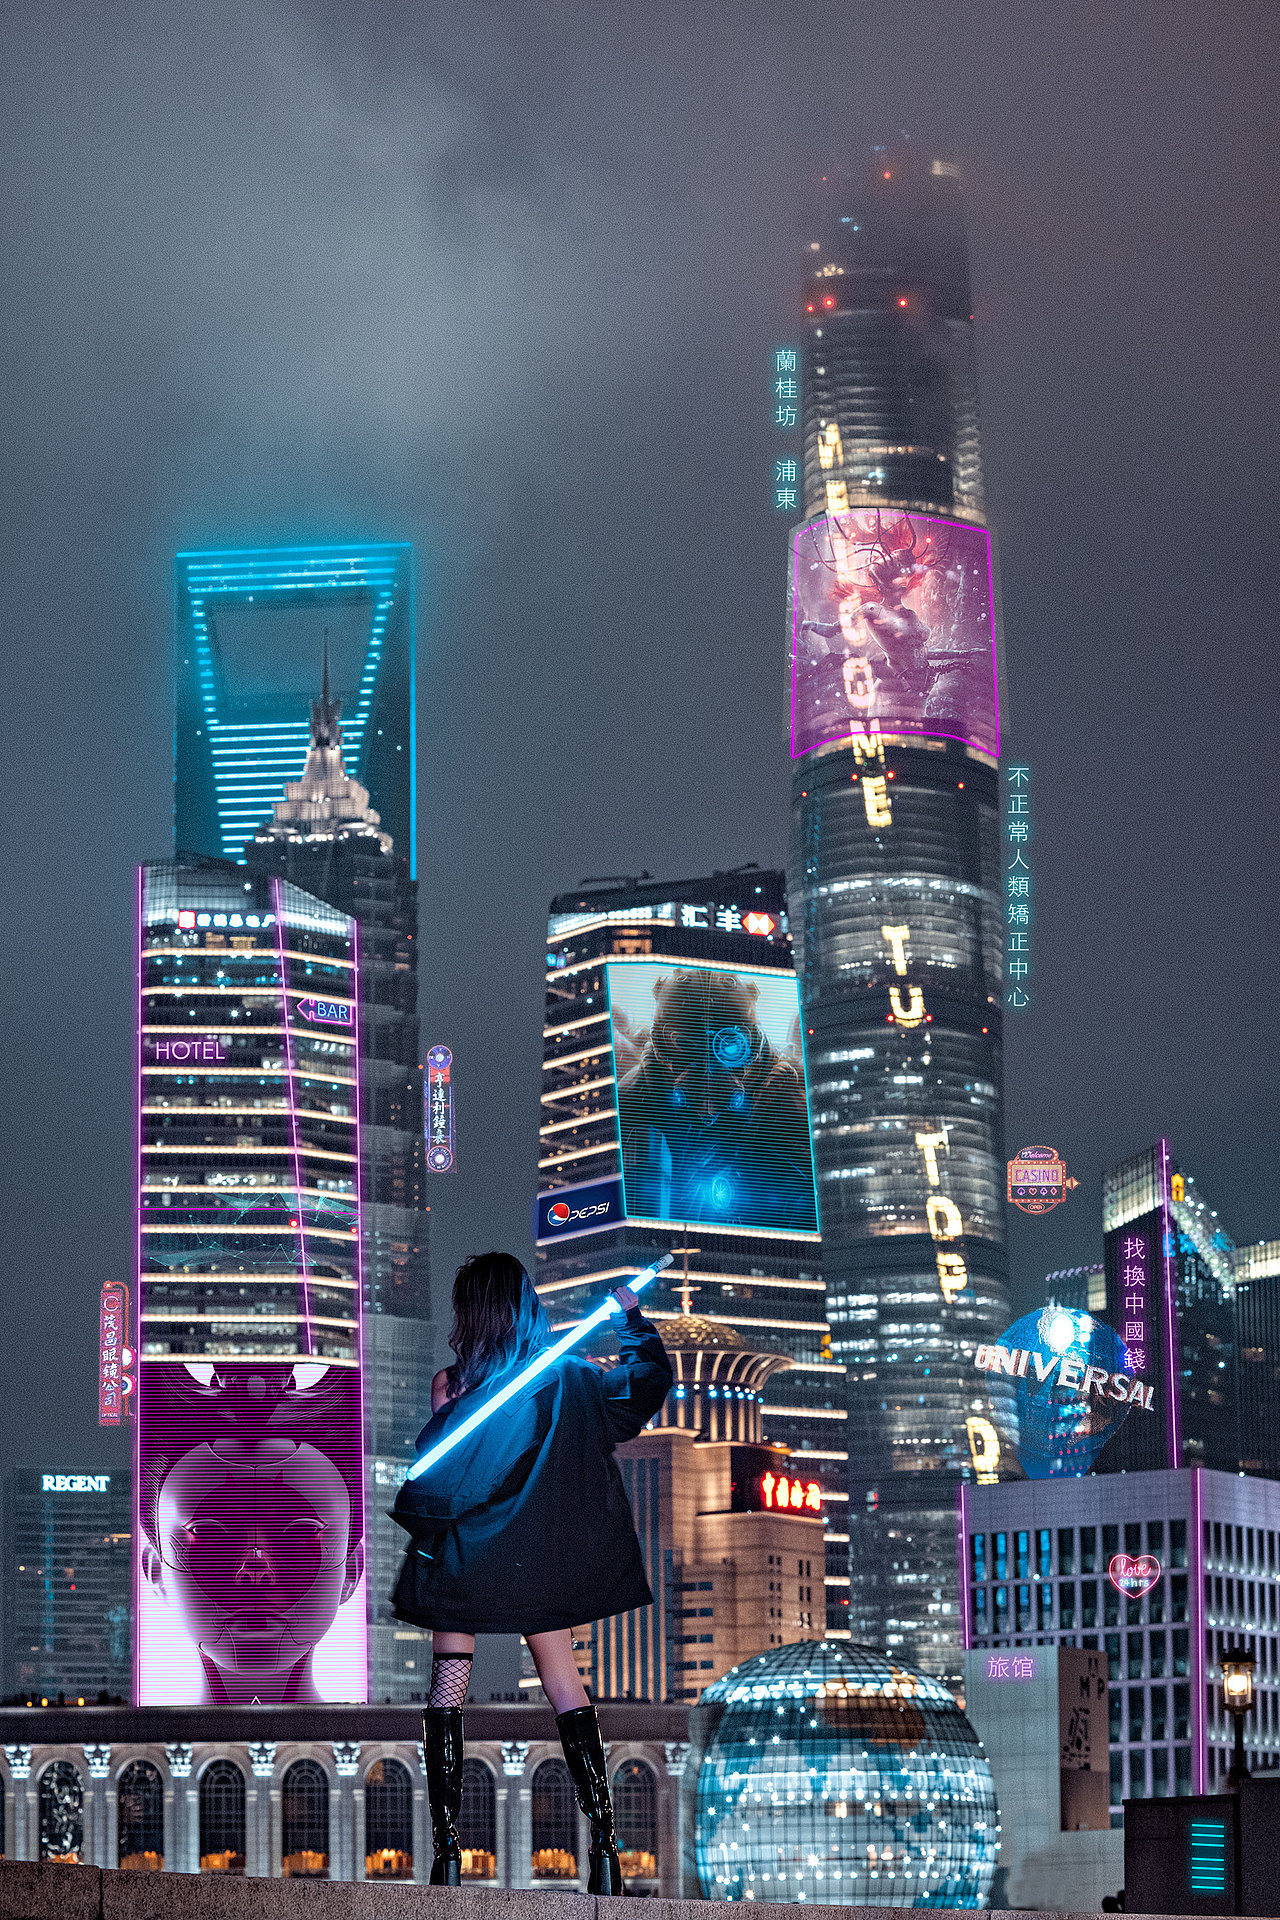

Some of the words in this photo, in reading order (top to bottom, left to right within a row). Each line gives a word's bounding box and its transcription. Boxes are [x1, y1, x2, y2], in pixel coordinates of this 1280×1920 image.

[775, 349, 798, 427] 蘭桂坊
[775, 459, 798, 510] 浦東
[1007, 767, 1030, 1007] 不正常人類矯正中心
[680, 903, 742, 932] 汇丰
[316, 1002, 348, 1020] BAR
[156, 1041, 226, 1060] HOTEL
[1015, 1169, 1059, 1183] CASINO
[568, 1201, 611, 1223] PEPSI
[1123, 1237, 1146, 1370] 找換中國錢
[974, 1344, 1155, 1412] UNIVERSAL
[41, 1474, 111, 1493] REGENT
[1120, 1558, 1152, 1577] love
[987, 1656, 1034, 1679] 旅馆
